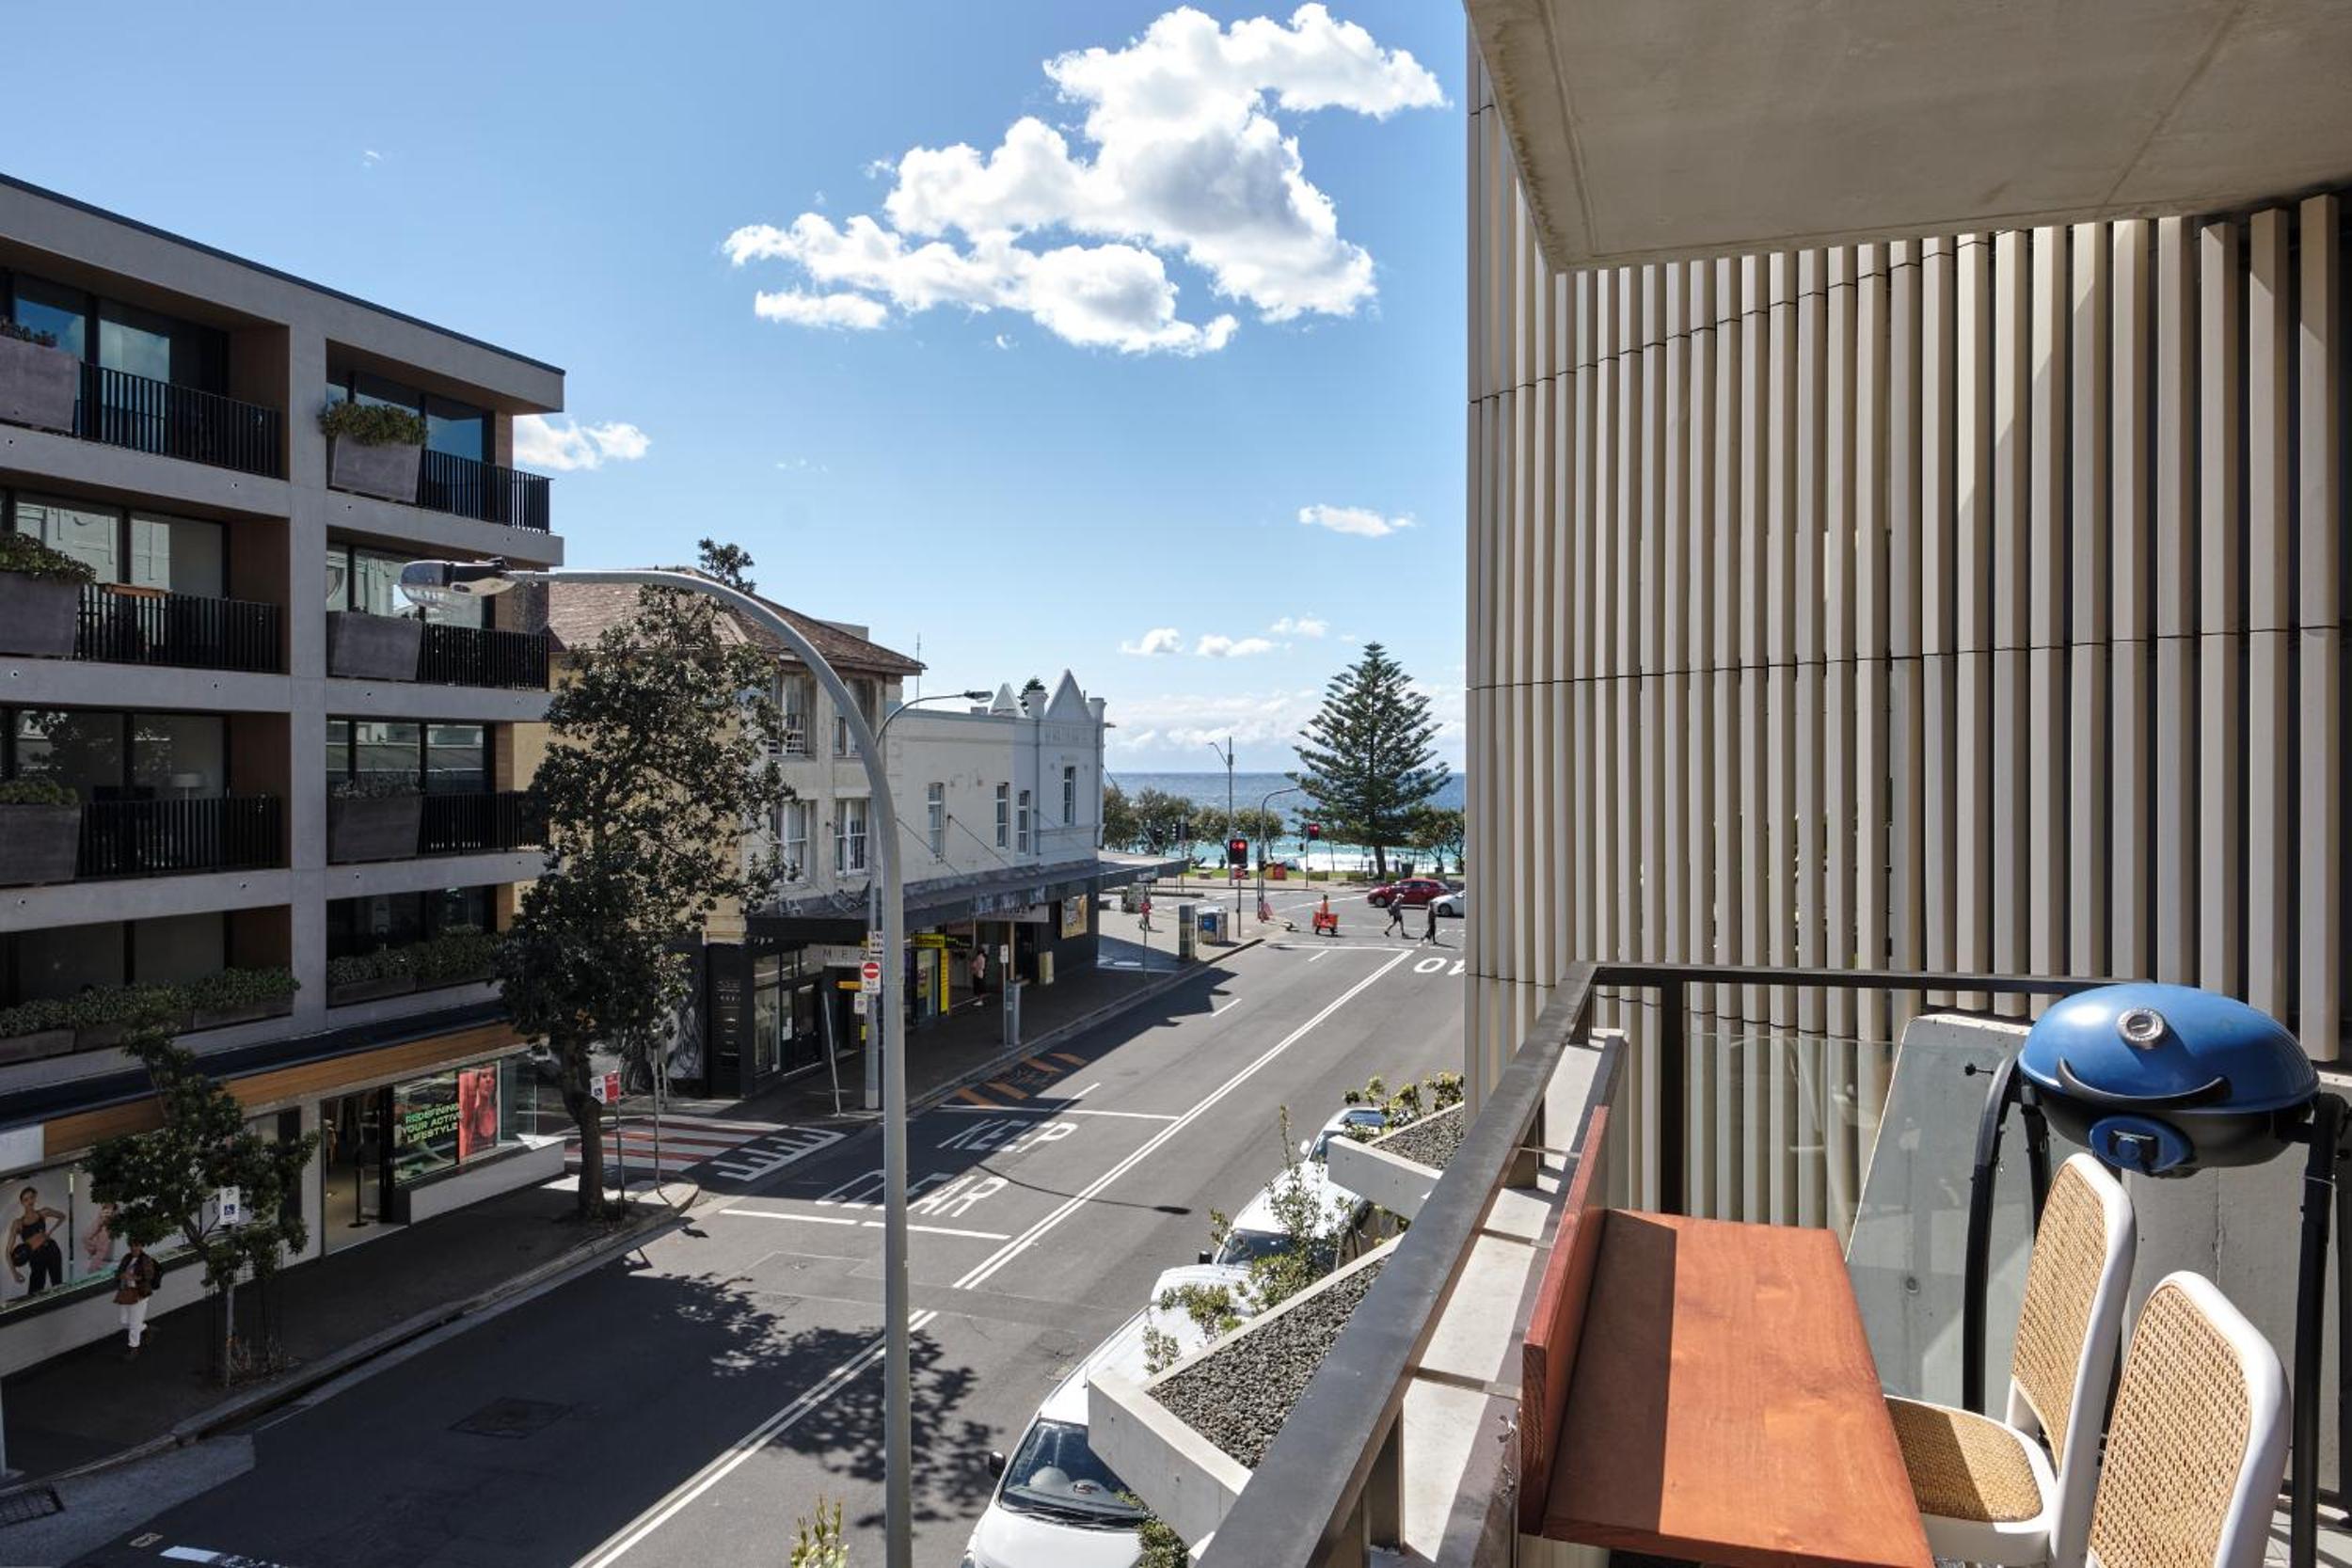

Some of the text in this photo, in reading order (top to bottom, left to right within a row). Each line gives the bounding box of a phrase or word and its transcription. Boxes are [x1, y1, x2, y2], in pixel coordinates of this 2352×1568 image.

[405, 1102, 459, 1122] REDEFINING
[406, 1122, 458, 1144] LIFESTYLE
[936, 1118, 1078, 1152] KEEP
